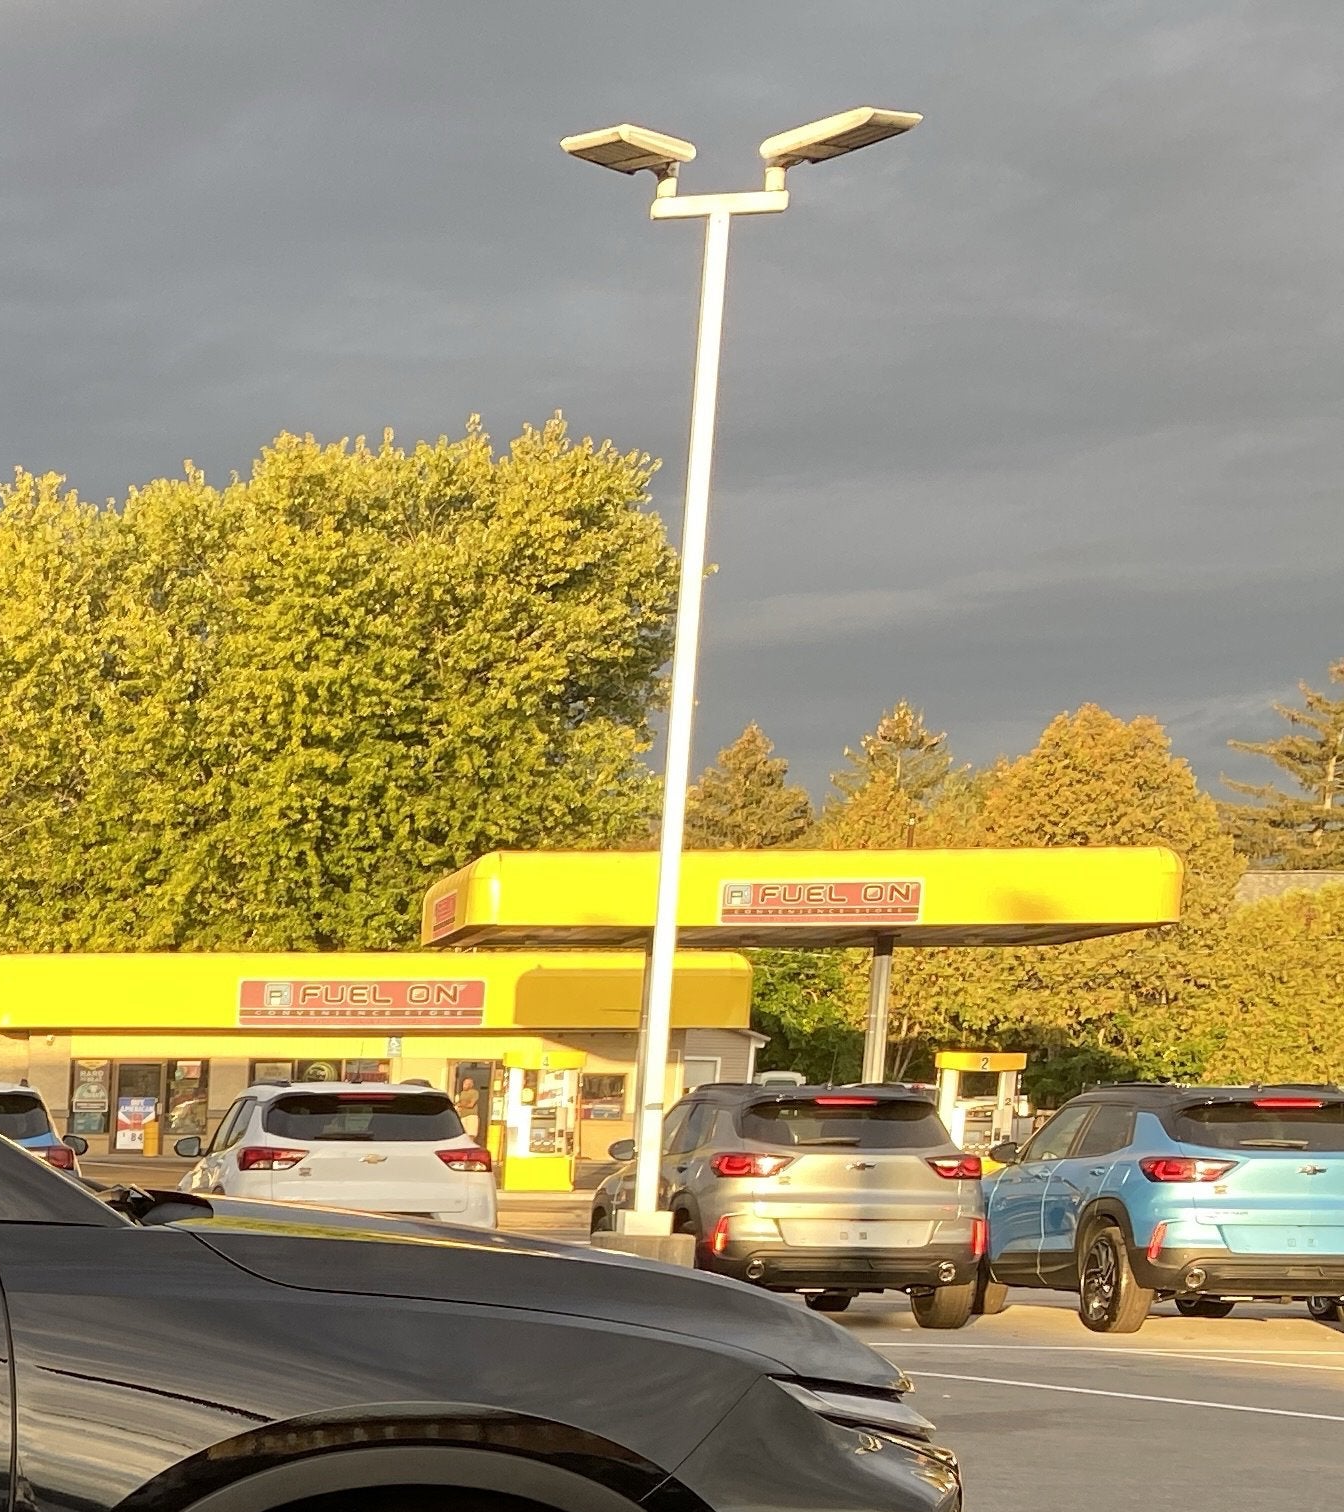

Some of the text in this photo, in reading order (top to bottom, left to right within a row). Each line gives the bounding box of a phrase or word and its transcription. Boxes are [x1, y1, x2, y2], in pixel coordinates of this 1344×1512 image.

[758, 883, 912, 905] FUEL ON
[298, 983, 460, 1006] FUEL ON
[980, 1057, 991, 1070] 2
